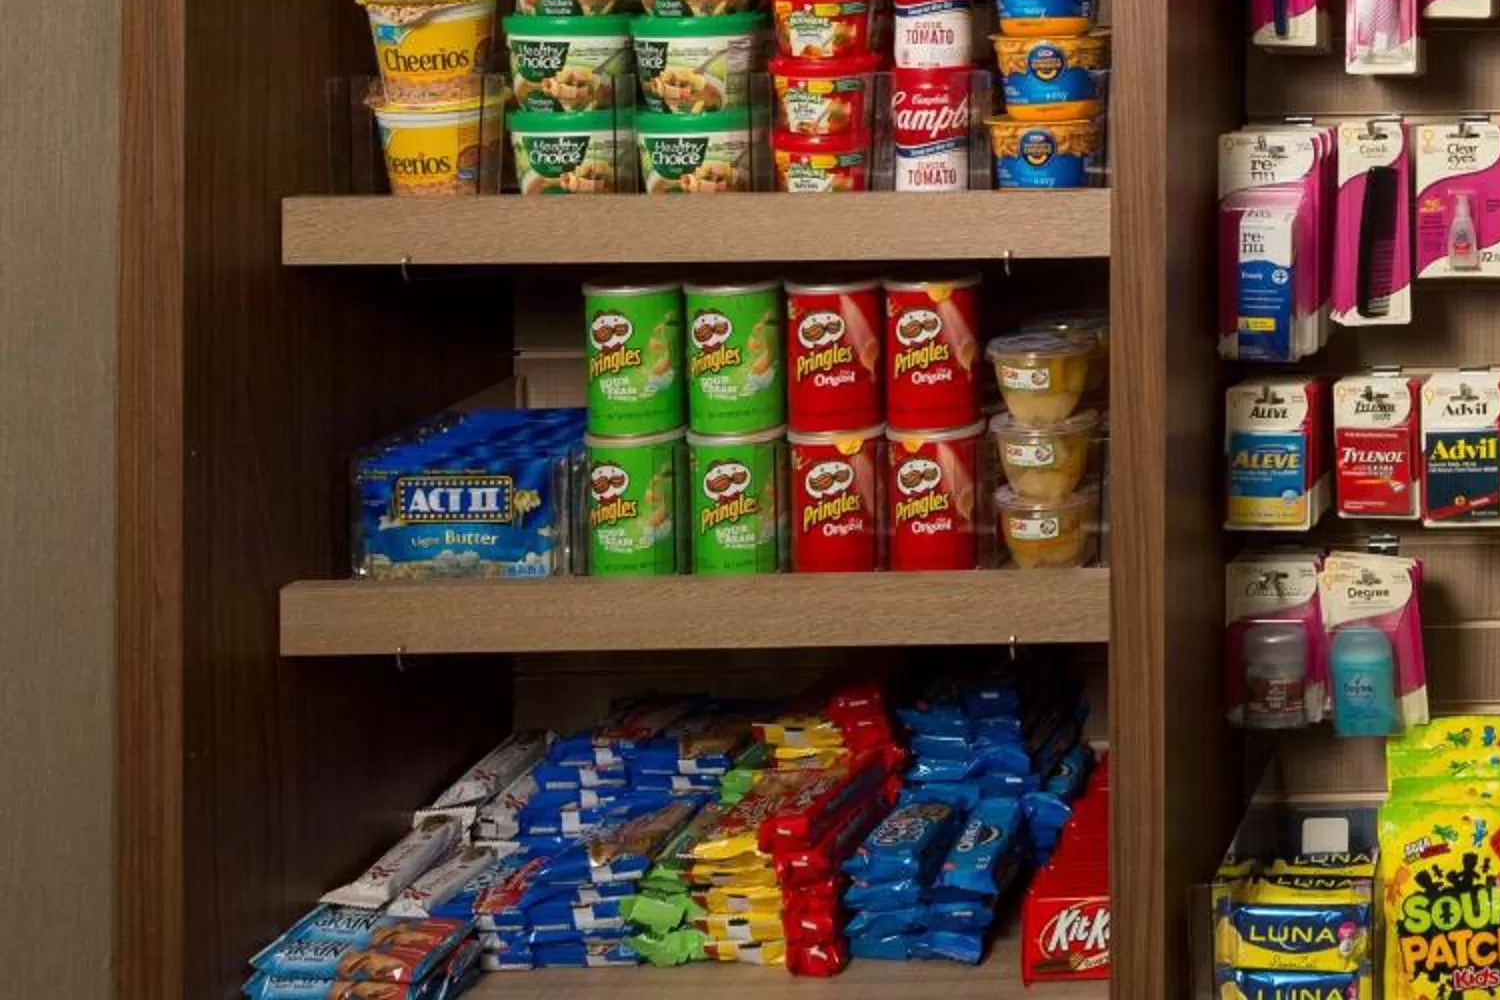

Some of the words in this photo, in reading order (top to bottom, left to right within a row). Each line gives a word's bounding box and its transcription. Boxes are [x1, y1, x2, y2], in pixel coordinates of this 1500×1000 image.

[905, 28, 955, 46] TOMATO
[383, 46, 470, 73] Cheerios
[532, 135, 587, 155] Healthy
[654, 135, 707, 155] Healthy
[1446, 142, 1480, 154] Clear
[528, 148, 583, 166] Choice
[650, 148, 701, 166] Choice
[1446, 152, 1478, 164] eyes
[907, 167, 957, 186] TOMATO
[797, 345, 853, 381] Pringles
[893, 343, 950, 378] Pringles
[1249, 406, 1289, 420] ALEVE
[1441, 402, 1489, 417] Advil
[1340, 446, 1404, 464] TYLENOL
[1430, 437, 1498, 461] Advil
[1232, 452, 1301, 471] ALEVE
[409, 487, 463, 513] ACT
[466, 487, 501, 512] II
[895, 491, 949, 527] Pringles
[700, 496, 760, 536] Pringles
[803, 492, 861, 533] Pringles
[444, 530, 500, 549] Butter
[1347, 586, 1391, 601] Degree
[1293, 852, 1374, 866] LUNA
[314, 915, 377, 932] GRAIN
[1249, 924, 1337, 944] LUNA
[1256, 987, 1340, 1000] LUNA
